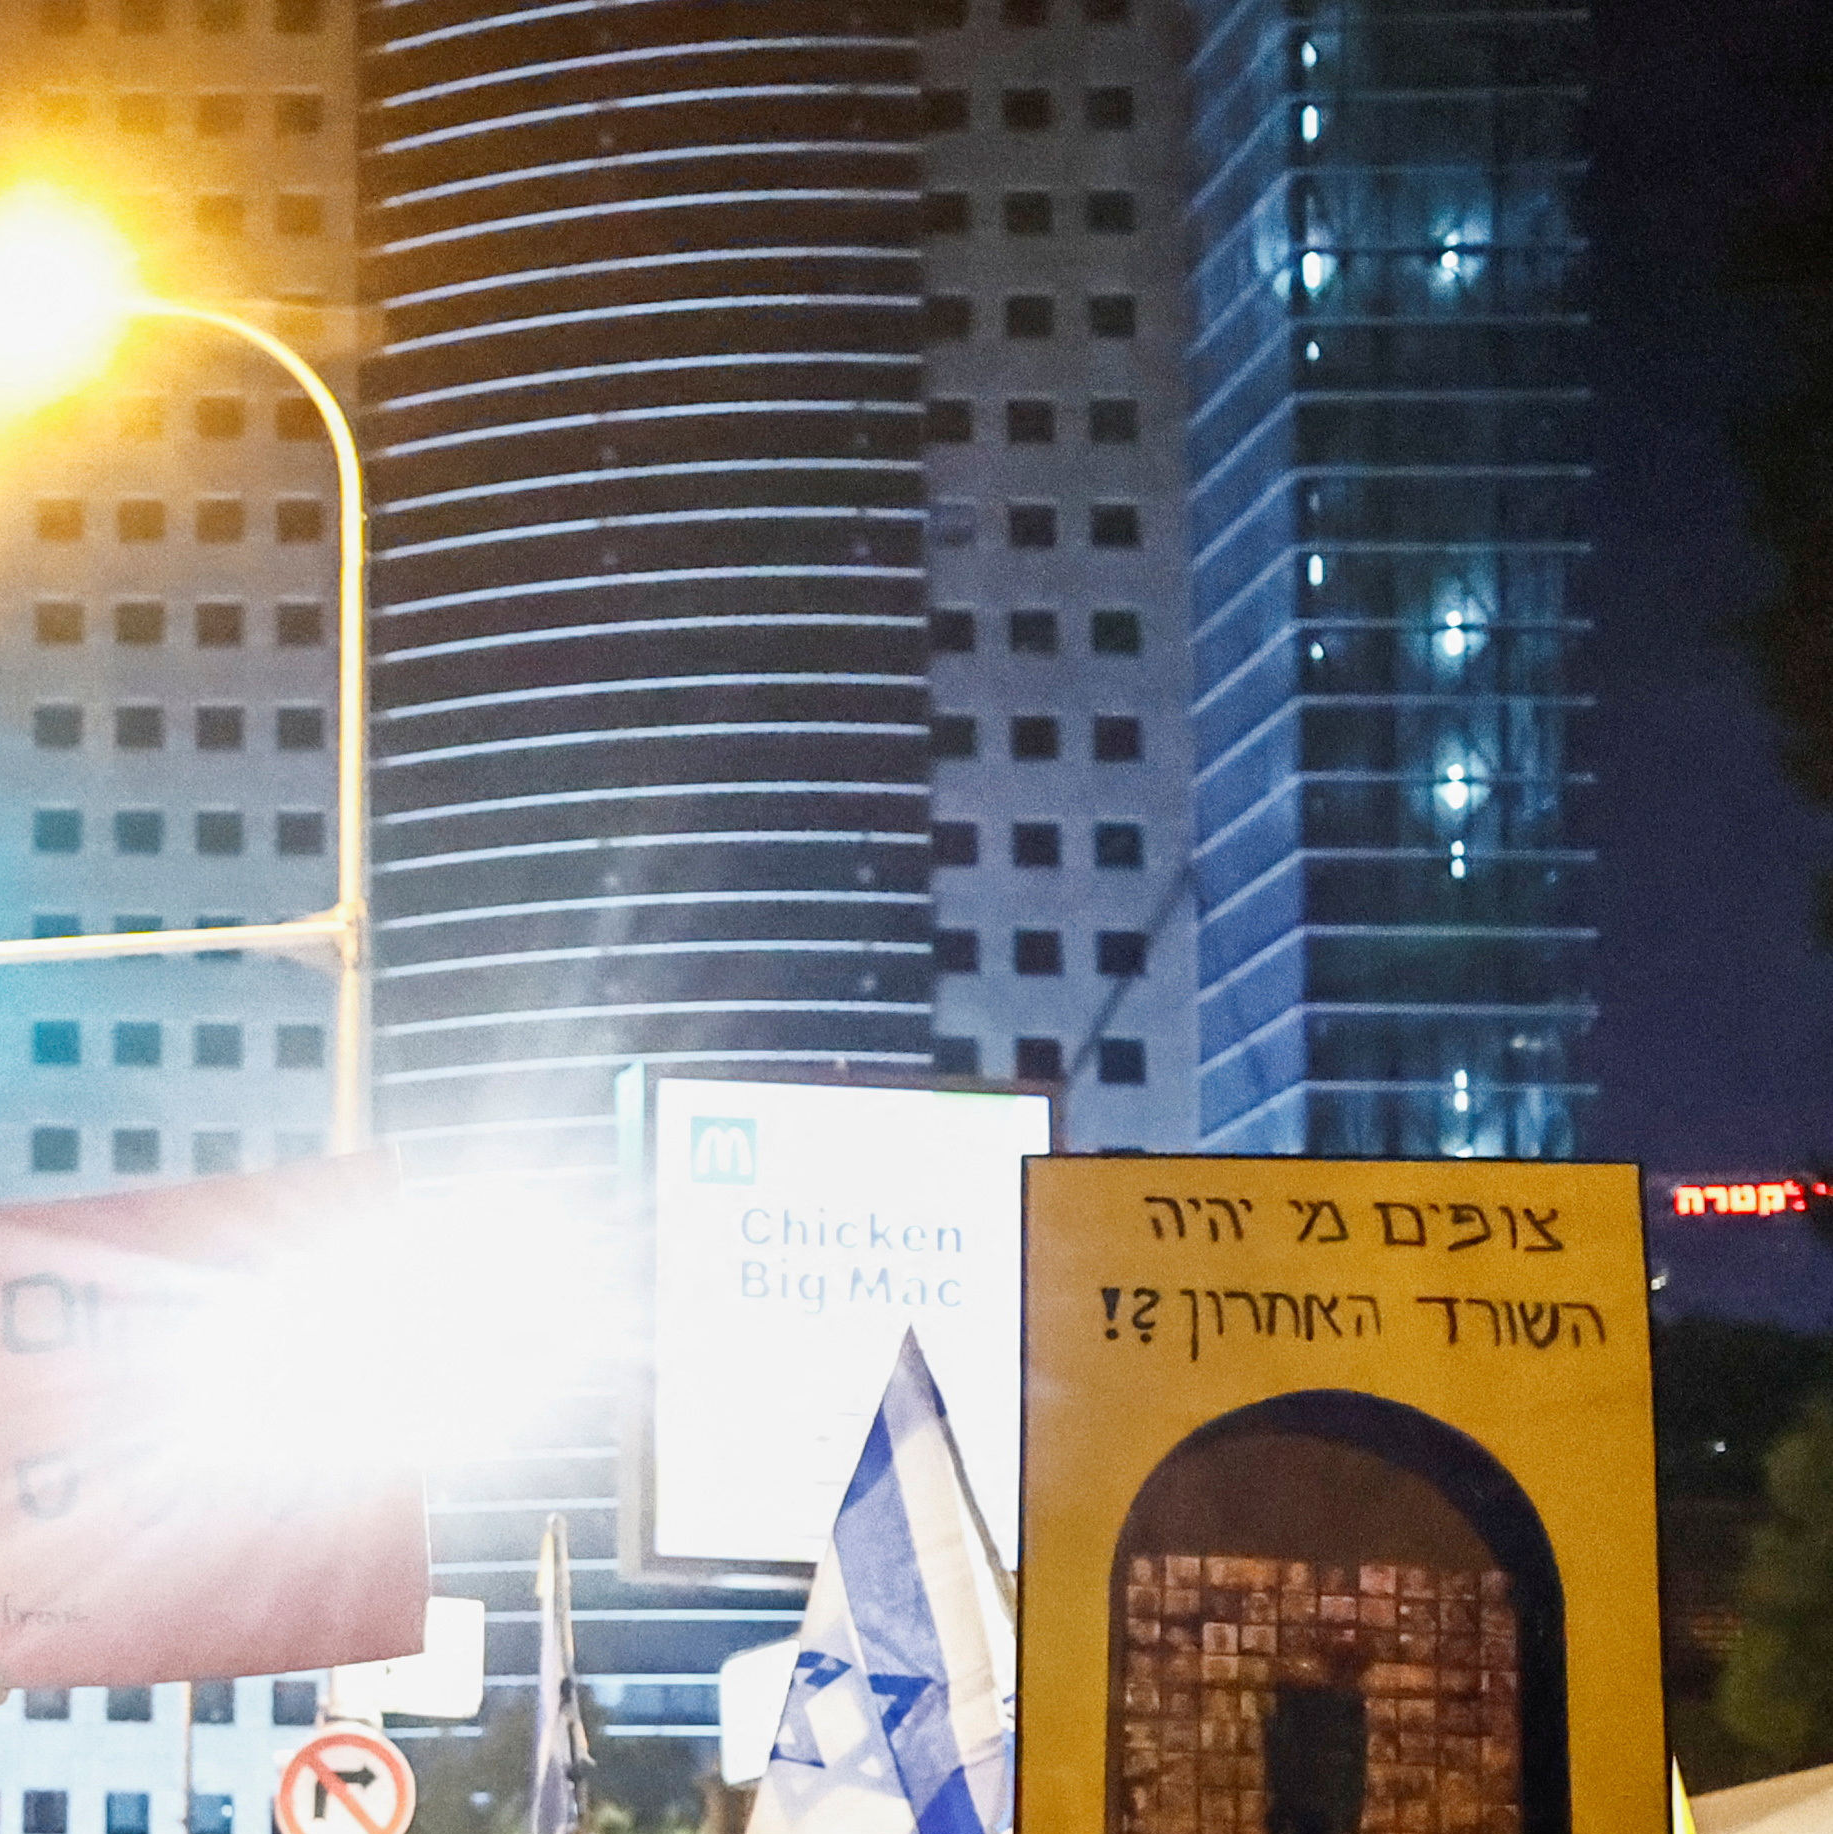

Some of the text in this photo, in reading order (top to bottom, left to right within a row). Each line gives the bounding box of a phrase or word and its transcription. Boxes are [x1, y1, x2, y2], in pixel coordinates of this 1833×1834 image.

[739, 1207, 964, 1254] Chicken
[1143, 1194, 1566, 1254] צופים מי יהיה
[739, 1258, 963, 1315] Big Mac
[1415, 1293, 1607, 1350] השורד
